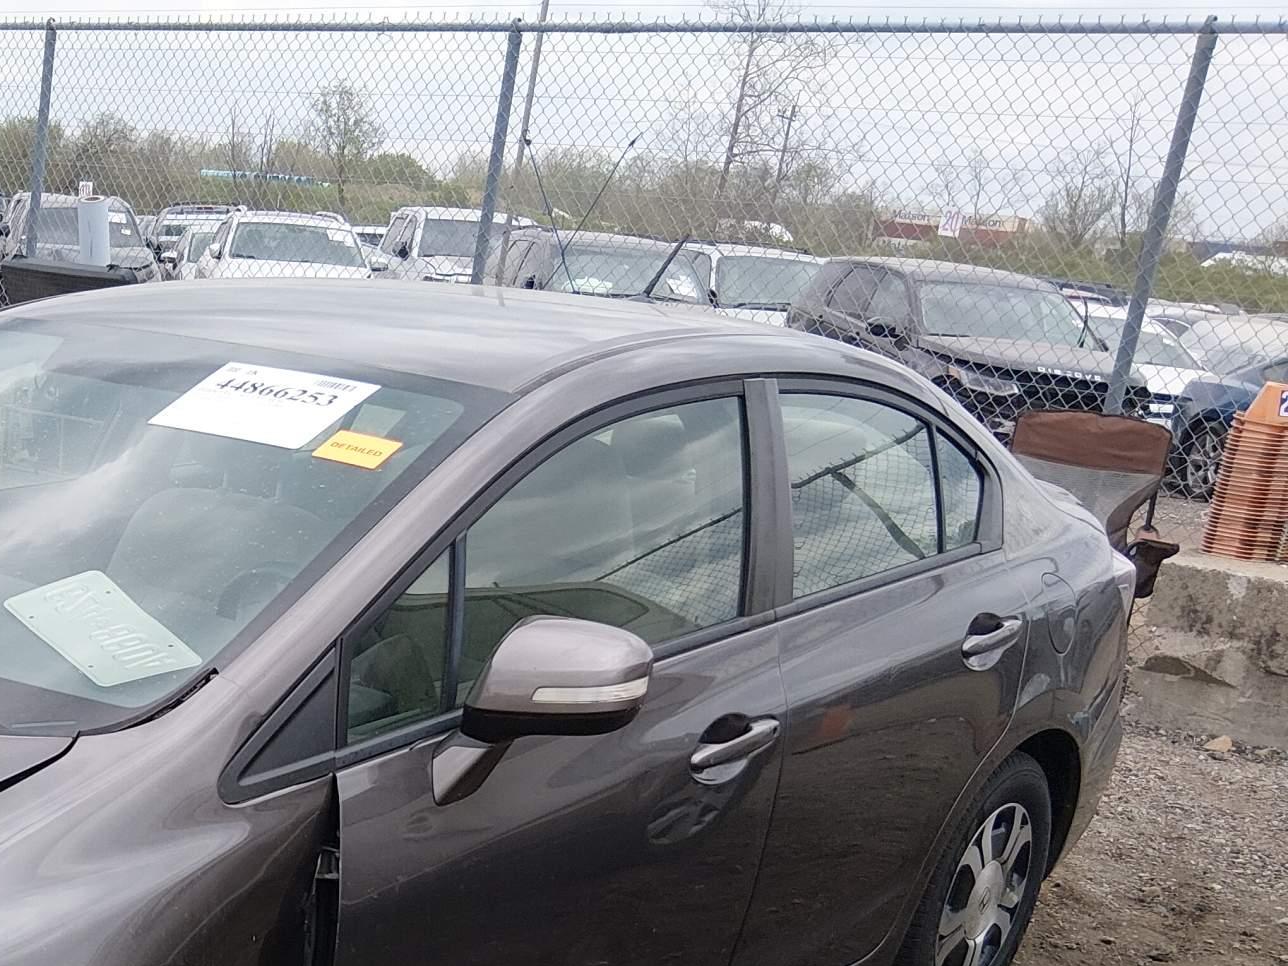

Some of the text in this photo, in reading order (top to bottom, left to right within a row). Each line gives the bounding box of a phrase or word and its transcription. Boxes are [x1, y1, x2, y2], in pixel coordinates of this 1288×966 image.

[942, 209, 959, 232] 20
[216, 377, 339, 407] 44866253
[329, 440, 384, 458] DETAILED
